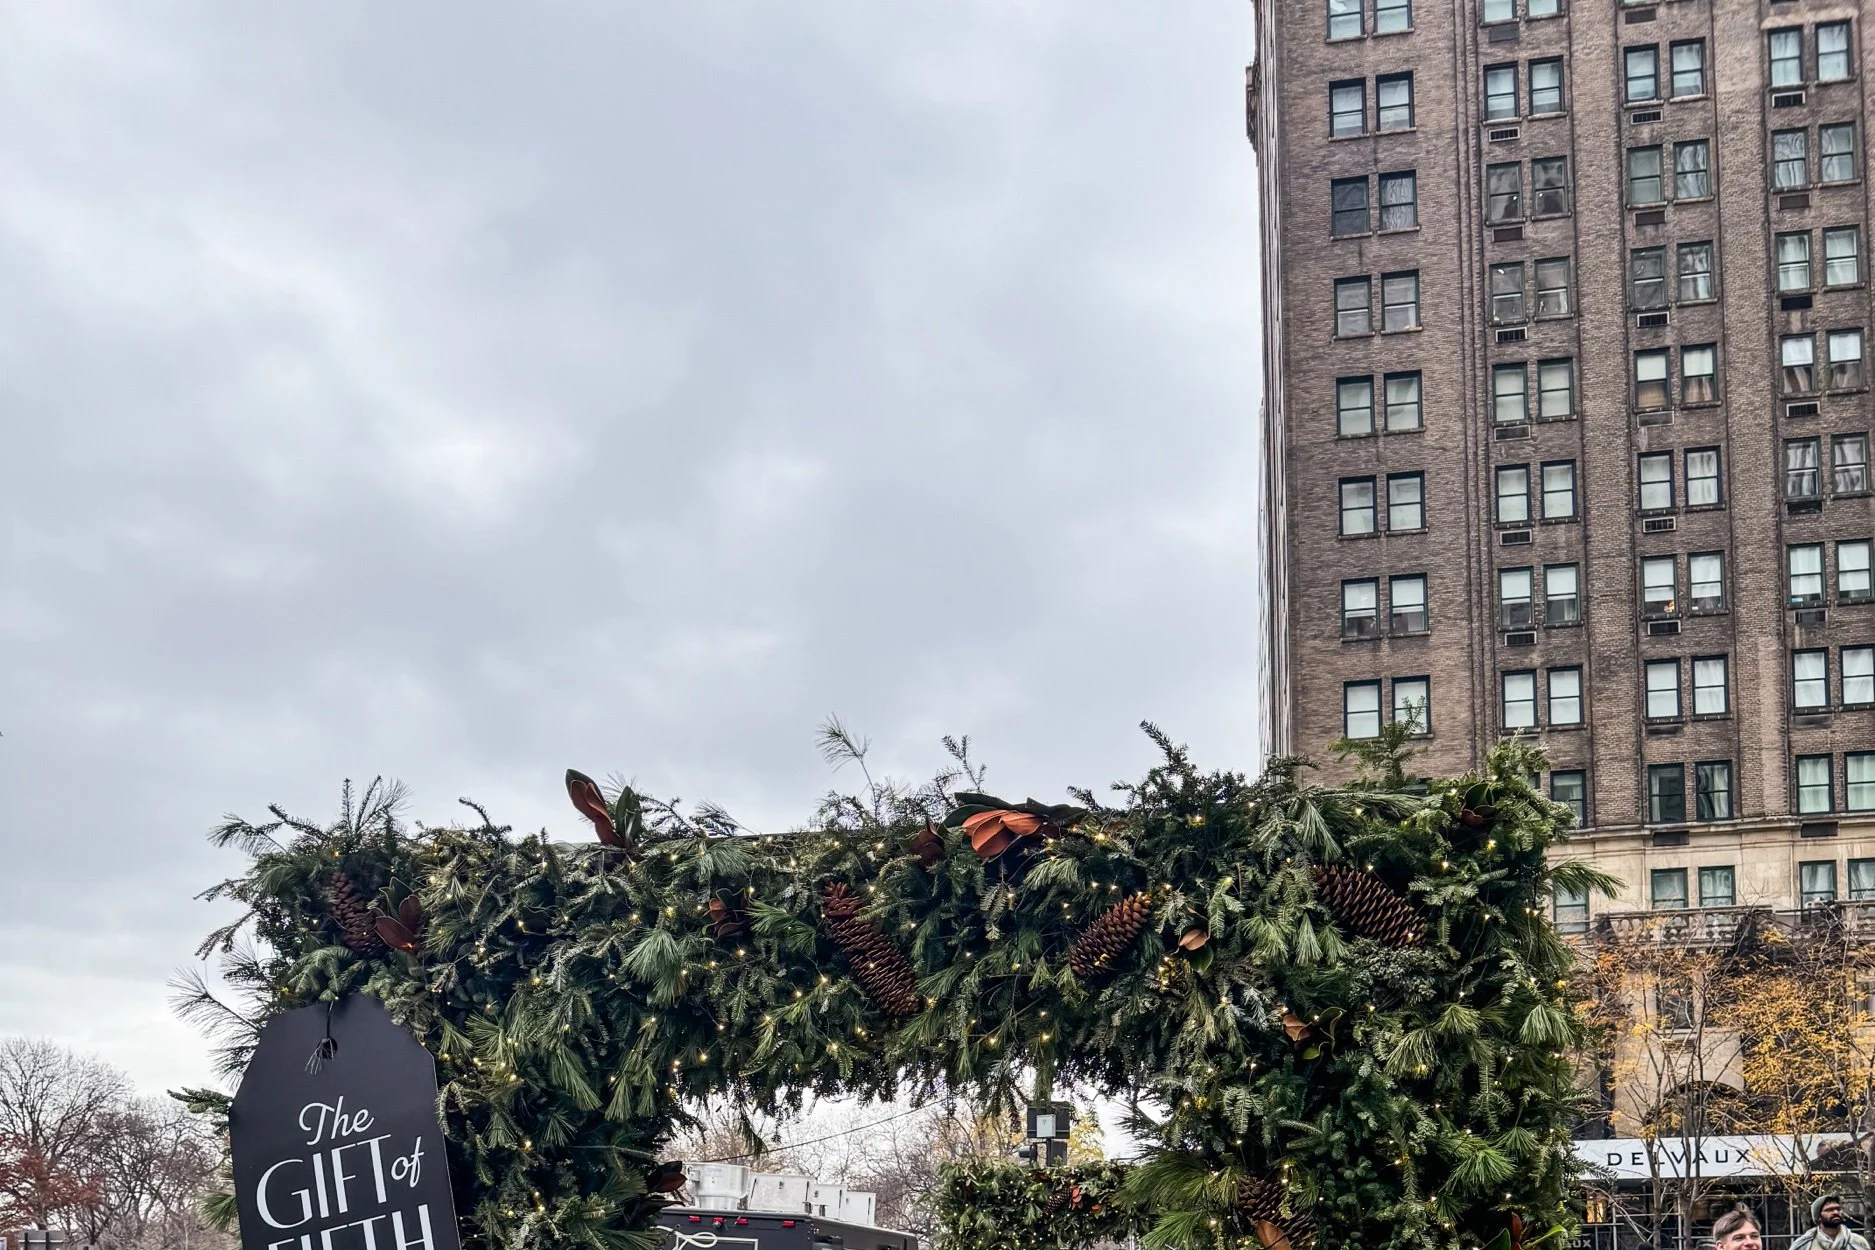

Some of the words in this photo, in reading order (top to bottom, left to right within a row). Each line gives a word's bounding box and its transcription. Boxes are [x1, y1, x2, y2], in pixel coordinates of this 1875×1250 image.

[298, 1095, 374, 1146] The
[256, 1134, 391, 1229] GIFT
[390, 1136, 425, 1188] of
[1607, 1149, 1750, 1166] DELVAUX
